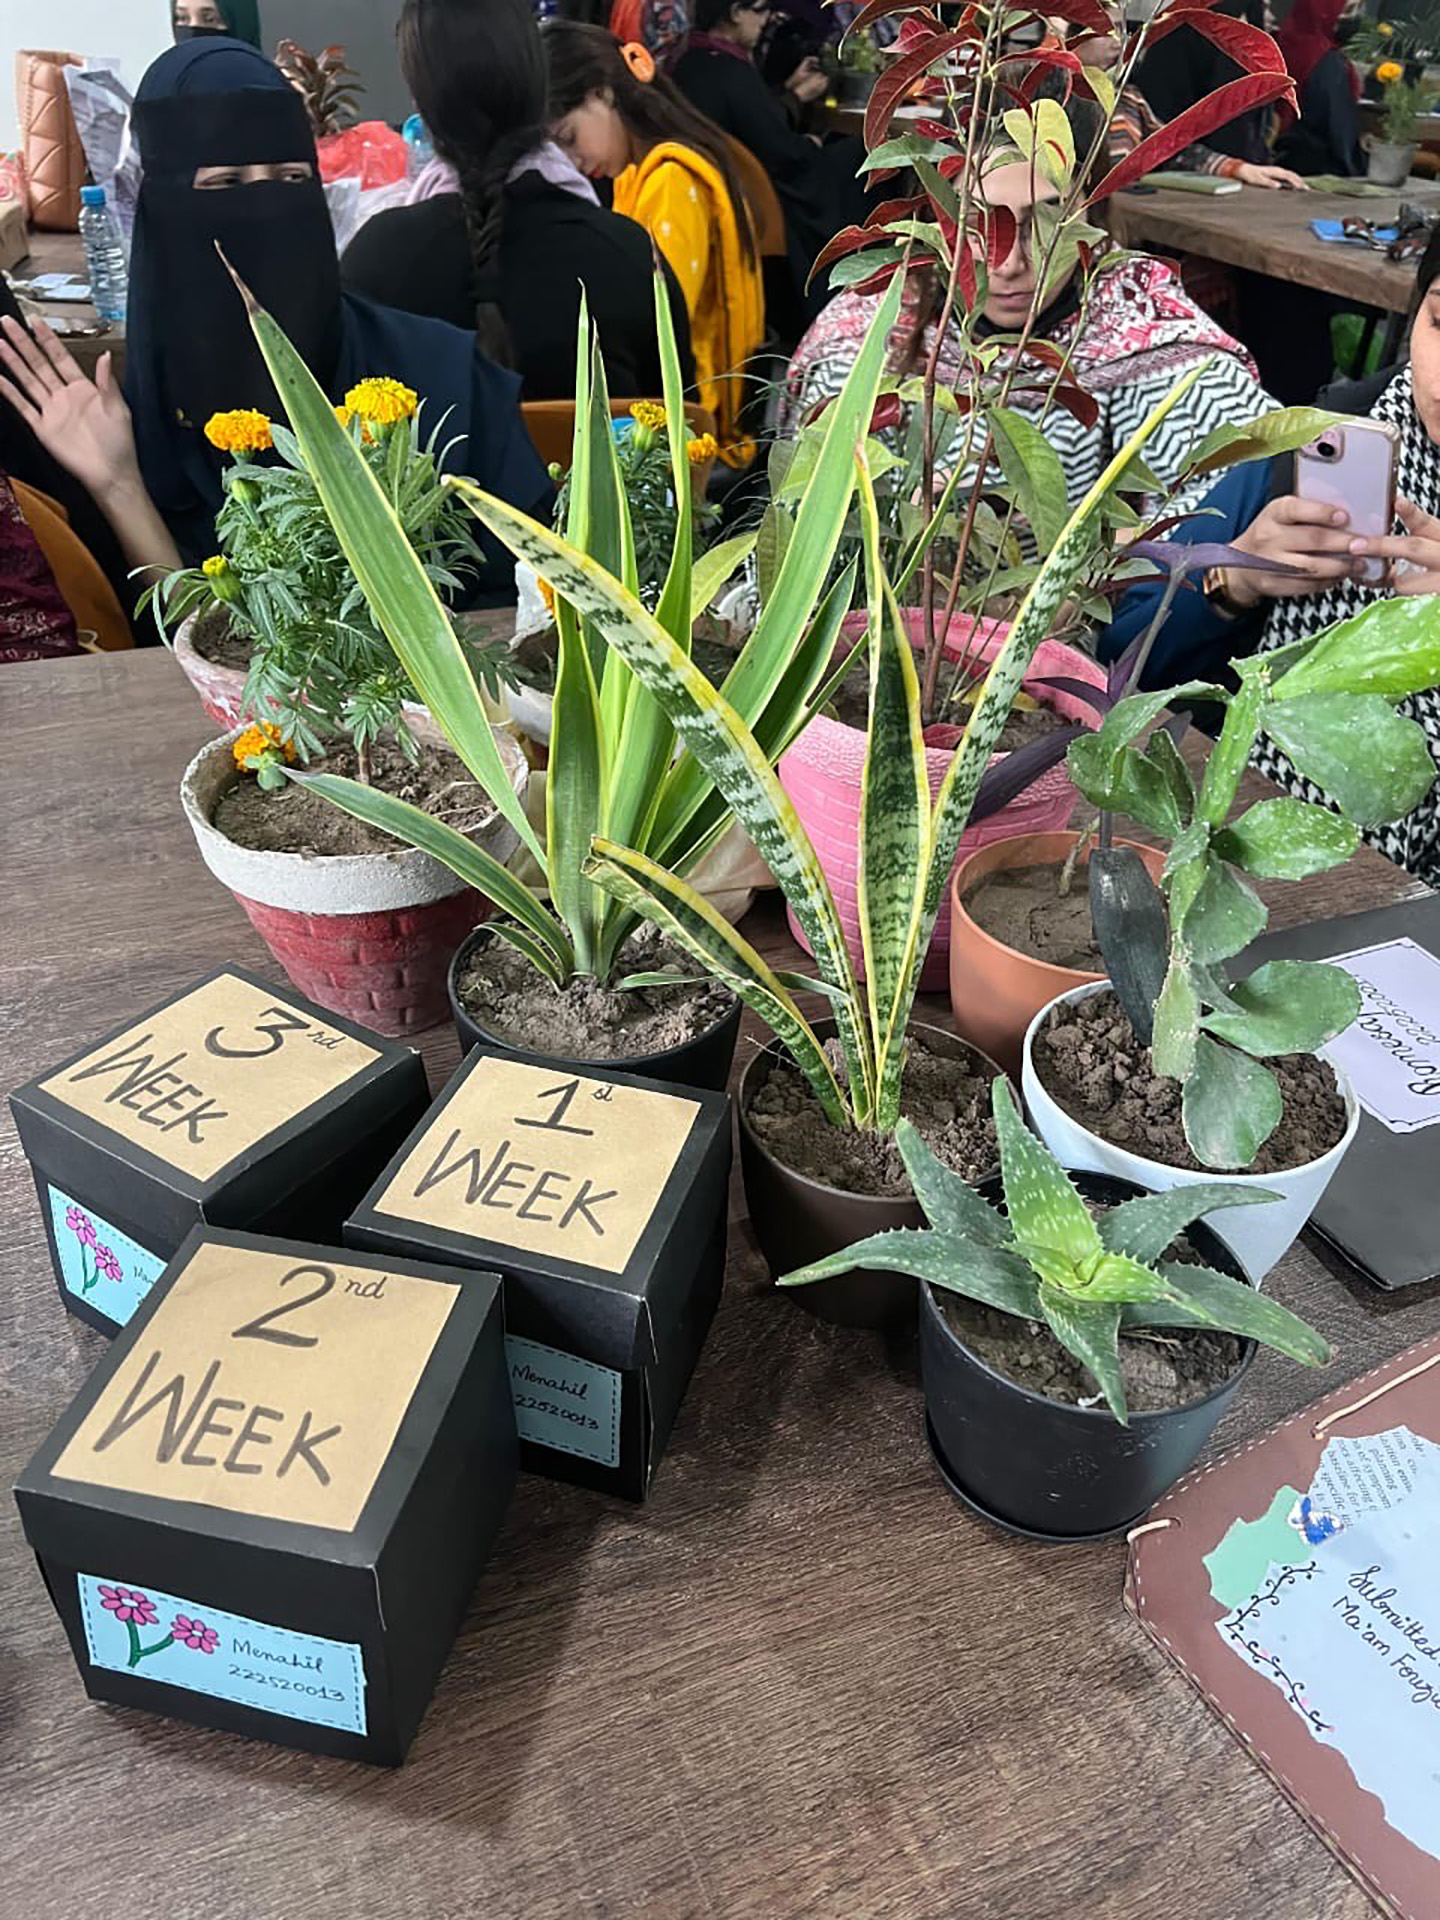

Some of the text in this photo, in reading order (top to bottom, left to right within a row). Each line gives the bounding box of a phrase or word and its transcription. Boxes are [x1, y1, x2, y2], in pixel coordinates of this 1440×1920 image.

[69, 1034, 228, 1143] WEEK
[414, 1129, 618, 1236] WEEK
[232, 1265, 388, 1348] 2nd
[93, 1351, 342, 1487] WEEK
[512, 1364, 588, 1400] Menahil
[233, 1638, 323, 1674] Menahil
[1348, 1565, 1440, 1660] Submitted
